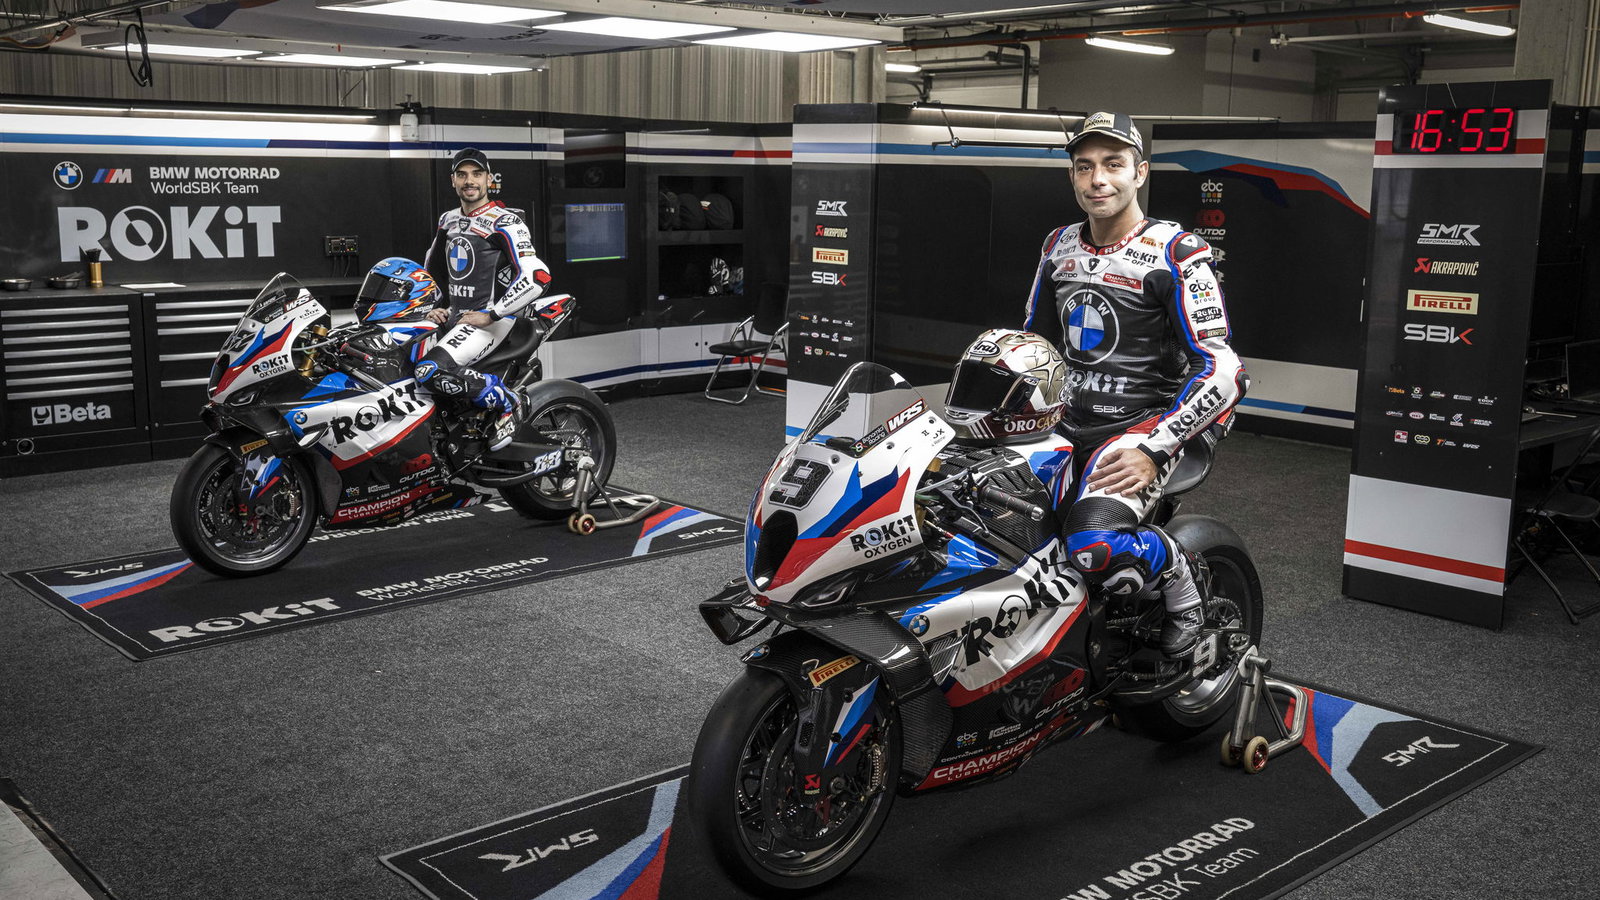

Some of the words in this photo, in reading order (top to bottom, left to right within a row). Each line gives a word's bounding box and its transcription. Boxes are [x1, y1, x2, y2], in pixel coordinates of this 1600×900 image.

[1411, 108, 1514, 152] 16:53
[150, 167, 190, 179] BMW
[195, 167, 280, 179] MOTORRAD
[150, 182, 221, 194] WorldSBK
[225, 182, 259, 194] Team
[1201, 179, 1223, 192] ebc
[816, 200, 848, 216] SMR
[57, 205, 282, 262] ROKiT
[1419, 223, 1481, 246] SMR
[816, 250, 845, 262] PIRELLI
[1125, 247, 1158, 264] ROKiT
[812, 271, 847, 286] SBK
[1430, 261, 1479, 276] AKRAPOVIČ
[1189, 279, 1214, 293] ebc
[1413, 293, 1473, 311] PIRELLI
[447, 324, 477, 349] ROK
[1403, 323, 1474, 345] SBK
[252, 354, 289, 374] ROKiT
[259, 365, 287, 378] OXYGEN
[1067, 370, 1128, 394] OKiT
[54, 402, 111, 424] Beta
[330, 381, 426, 445] ROKiT
[1093, 405, 1125, 413] SBK
[1167, 385, 1223, 438] ROKiT
[1193, 398, 1227, 428] MOTORRAD
[400, 466, 435, 484] OUTDO
[338, 492, 410, 517] CHAMPION
[678, 526, 738, 540] SMR
[850, 514, 915, 552] ROKiT
[864, 535, 912, 558] OXYGEN
[356, 580, 418, 597] BMW
[422, 556, 549, 584] MOTORRAD
[368, 576, 478, 601] WorldSBK
[479, 567, 533, 580] Team
[961, 542, 1079, 666] ROKiT
[149, 597, 341, 642] ROKiT
[813, 655, 857, 682] PIRELLI
[956, 731, 978, 742] ebc
[934, 733, 1040, 779] CHAMPION
[1382, 736, 1460, 767] SMR
[947, 749, 1024, 780] LUBRICANTS
[1103, 818, 1255, 890] MOTORRAD
[1184, 847, 1260, 878] Team
